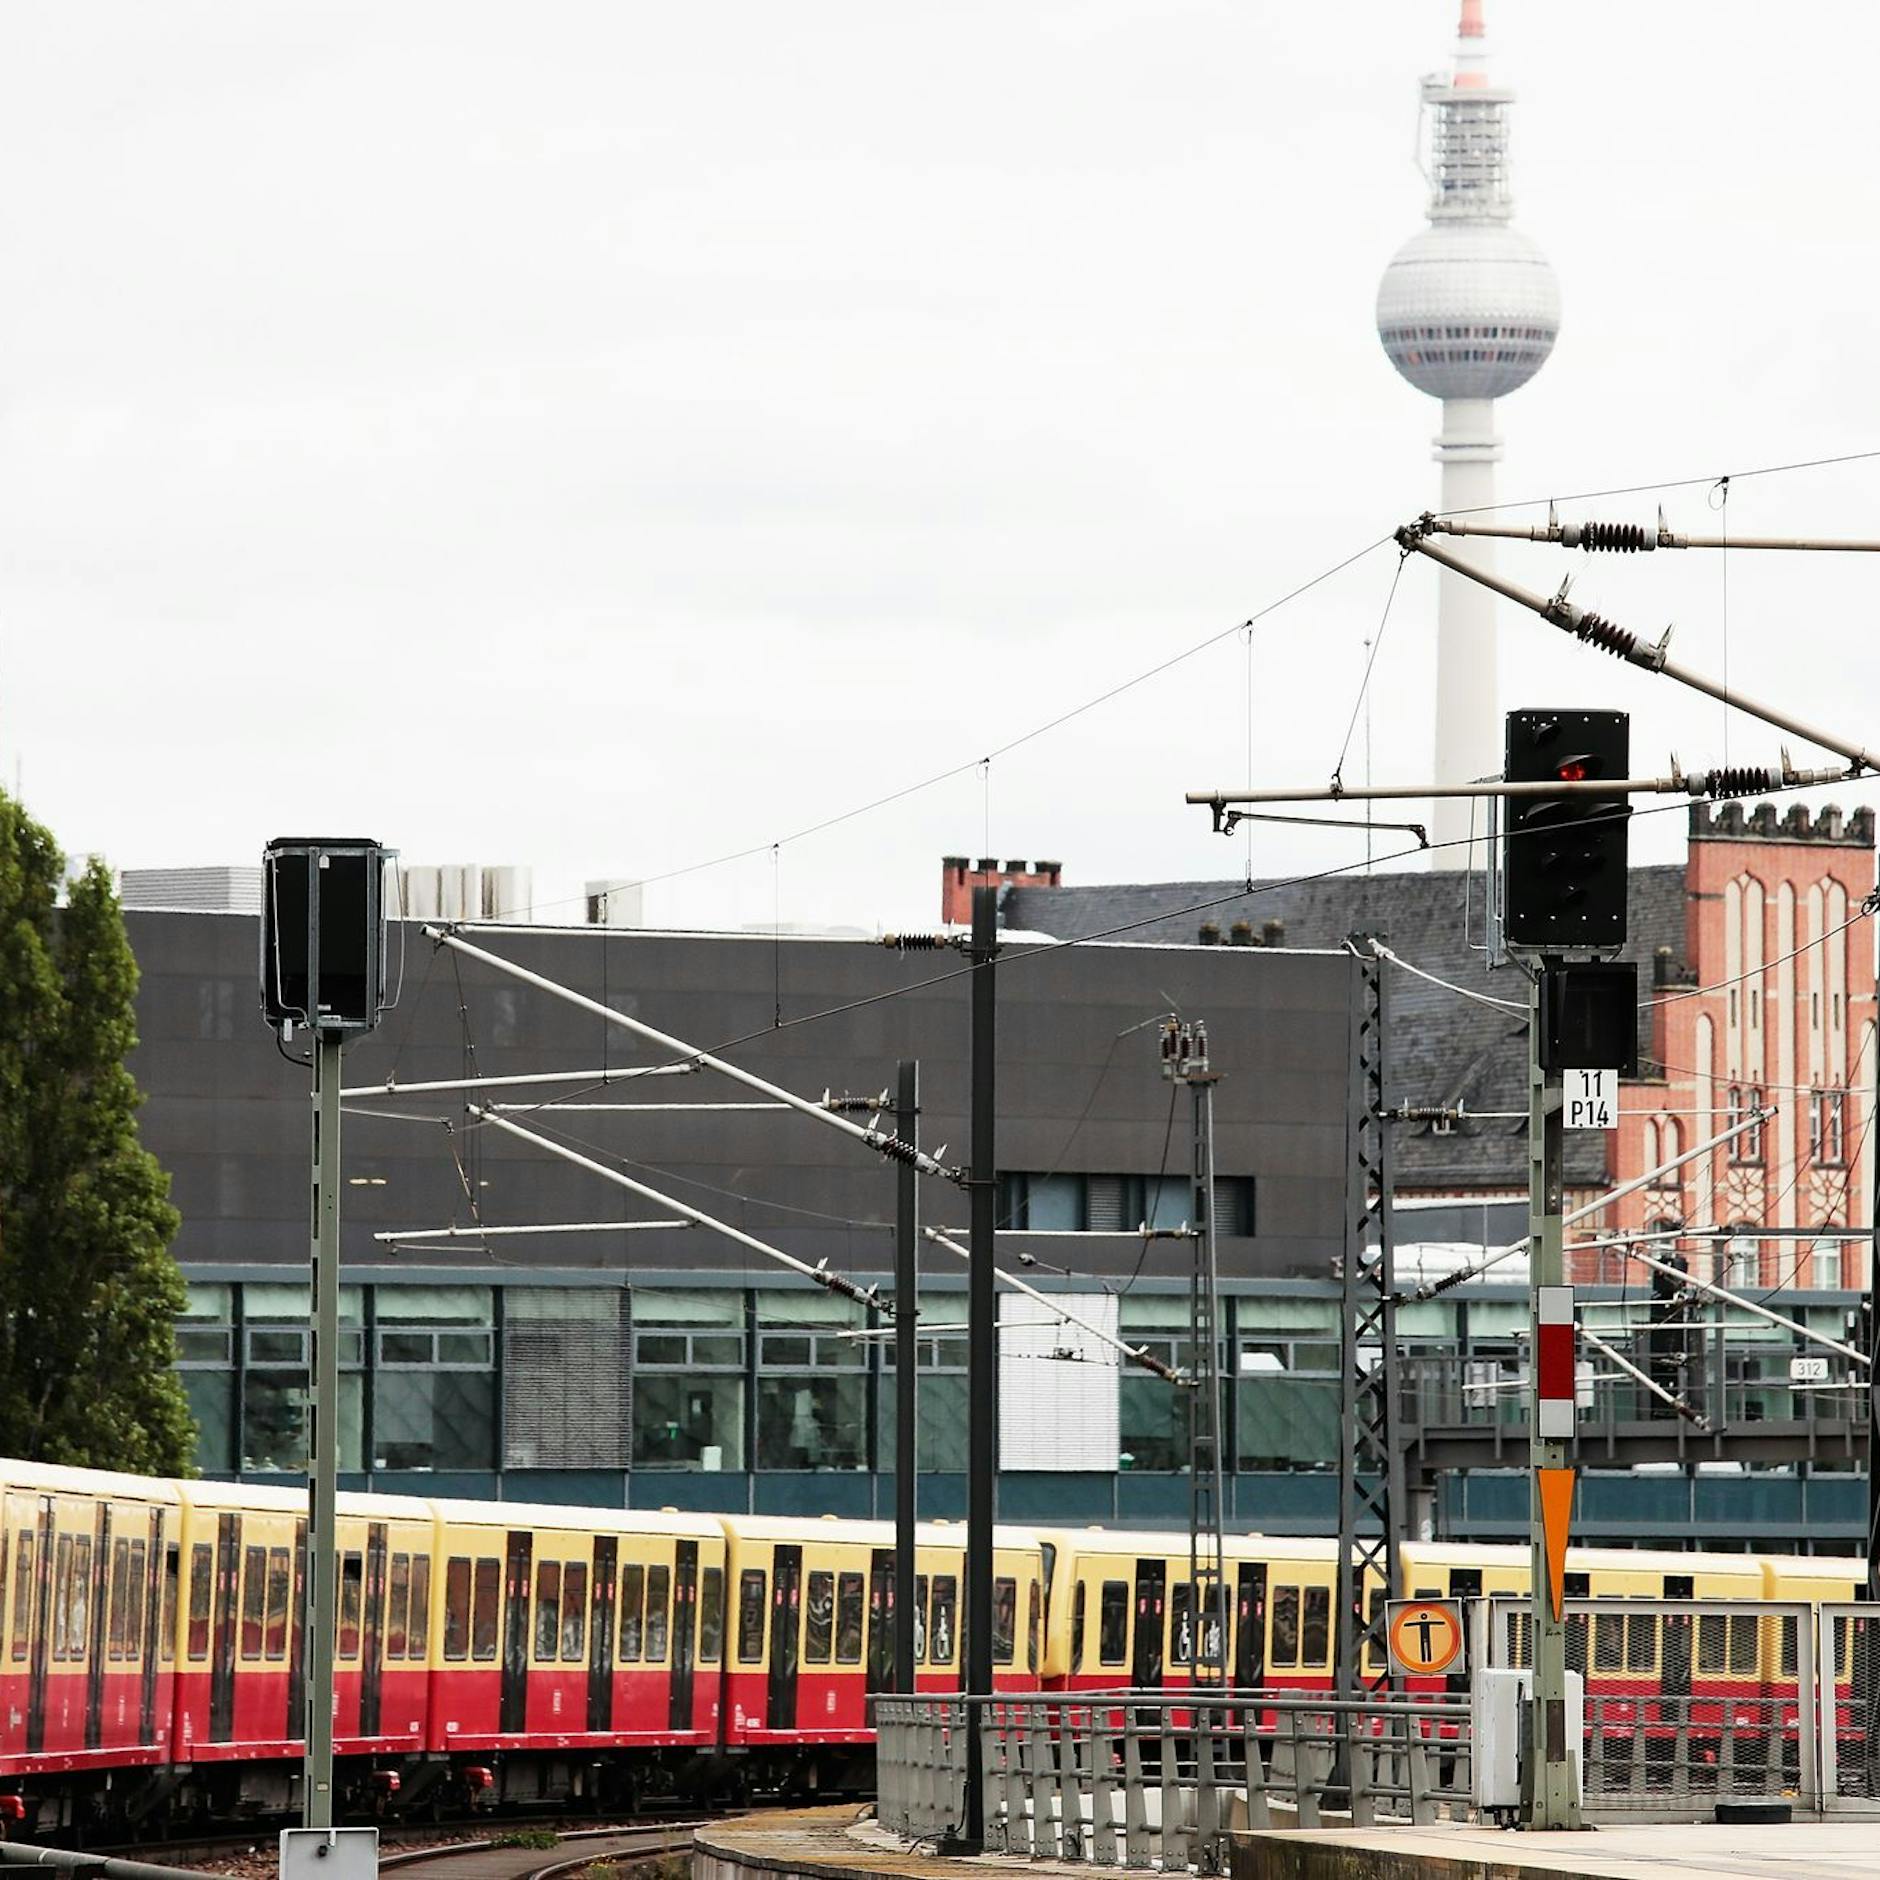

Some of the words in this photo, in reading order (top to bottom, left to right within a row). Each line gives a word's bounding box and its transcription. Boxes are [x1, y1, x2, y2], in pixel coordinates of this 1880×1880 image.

[1581, 1072, 1602, 1097] 11
[1571, 1100, 1609, 1125] P14
[1798, 1362, 1821, 1376] 312
